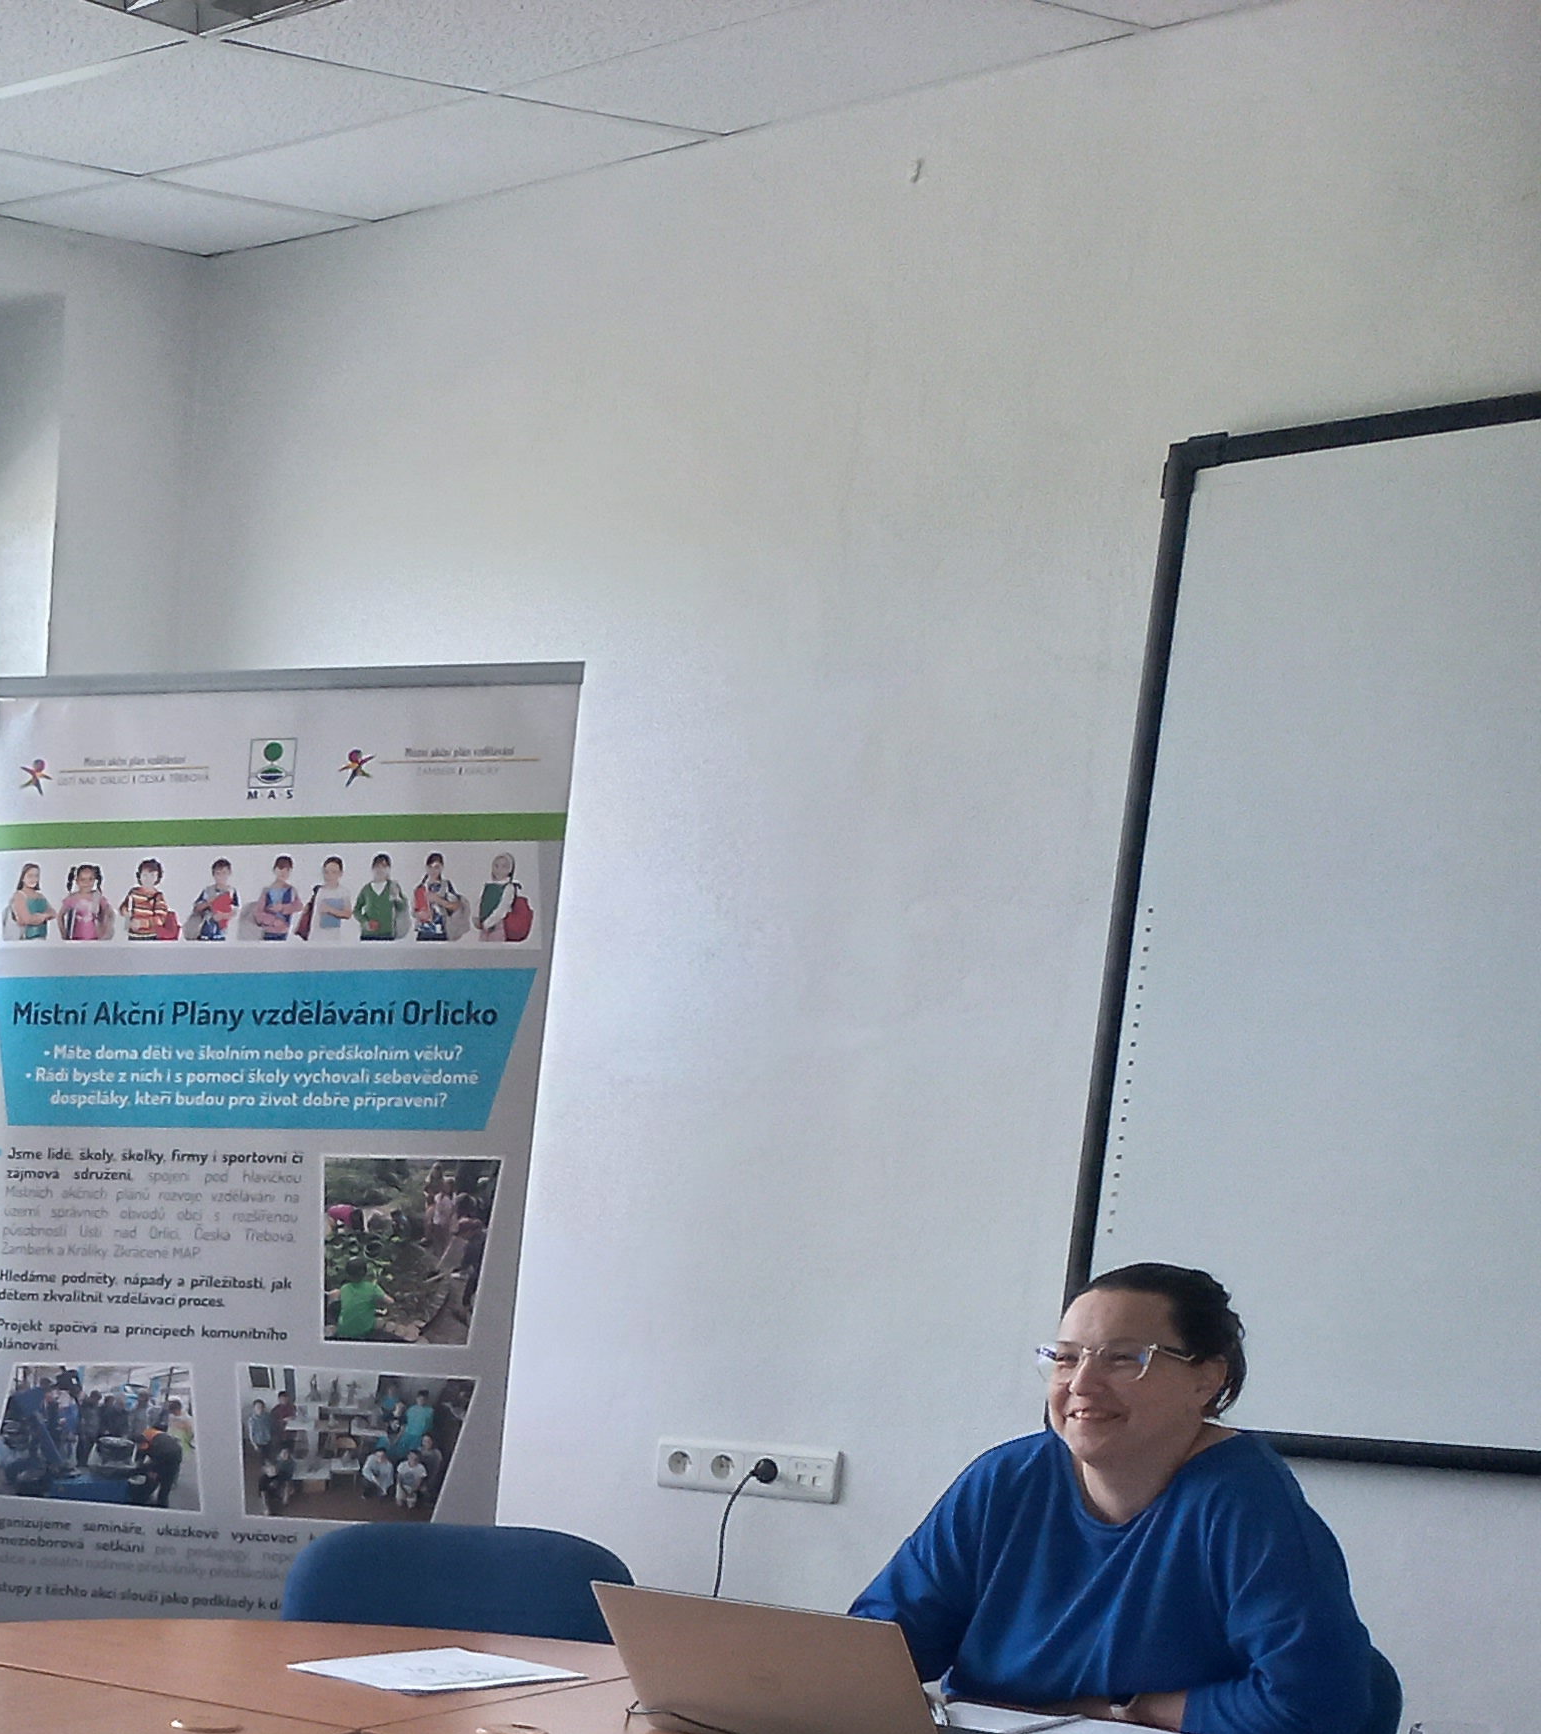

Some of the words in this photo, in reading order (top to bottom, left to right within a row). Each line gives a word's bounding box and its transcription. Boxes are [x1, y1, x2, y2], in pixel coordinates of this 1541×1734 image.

[13, 1001, 88, 1026] Místní
[93, 1000, 166, 1026] Akční
[171, 1000, 244, 1032] Plány
[252, 999, 396, 1026] vzdělávání
[403, 999, 498, 1026] Orlicko
[53, 1044, 91, 1060] Máte
[95, 1044, 139, 1060] doma
[142, 1044, 173, 1060] děti
[176, 1048, 194, 1060] ve
[198, 1044, 259, 1060] školním
[264, 1044, 303, 1060] nebo
[308, 1044, 410, 1063] předškolním
[414, 1044, 463, 1061] věku?
[35, 1067, 68, 1083] Rádi
[72, 1067, 115, 1086] byste
[118, 1072, 127, 1083] z
[175, 1072, 182, 1083] s
[248, 1067, 290, 1087] školy
[293, 1068, 370, 1087] vychovali
[373, 1068, 479, 1084] sebevědomé
[135, 1091, 172, 1106] kteří
[175, 1091, 224, 1106] budou
[228, 1094, 255, 1109] pro
[259, 1092, 298, 1107] život
[303, 1092, 350, 1107] dobře
[7, 1147, 43, 1160] Jsme
[171, 1149, 208, 1166] firmy
[222, 1151, 287, 1166] sportovní
[292, 1151, 304, 1164] či
[7, 1167, 60, 1182] zájmová
[204, 1171, 229, 1186] pod
[284, 1193, 300, 1203] na
[114, 1226, 137, 1239] nad
[0, 1269, 57, 1283] Hledáme
[124, 1273, 172, 1289] nápady
[177, 1277, 185, 1287] a
[270, 1276, 292, 1293] jak
[43, 1289, 103, 1304] zkvalitnit
[104, 1325, 120, 1334] na
[258, 1597, 266, 1610] k
